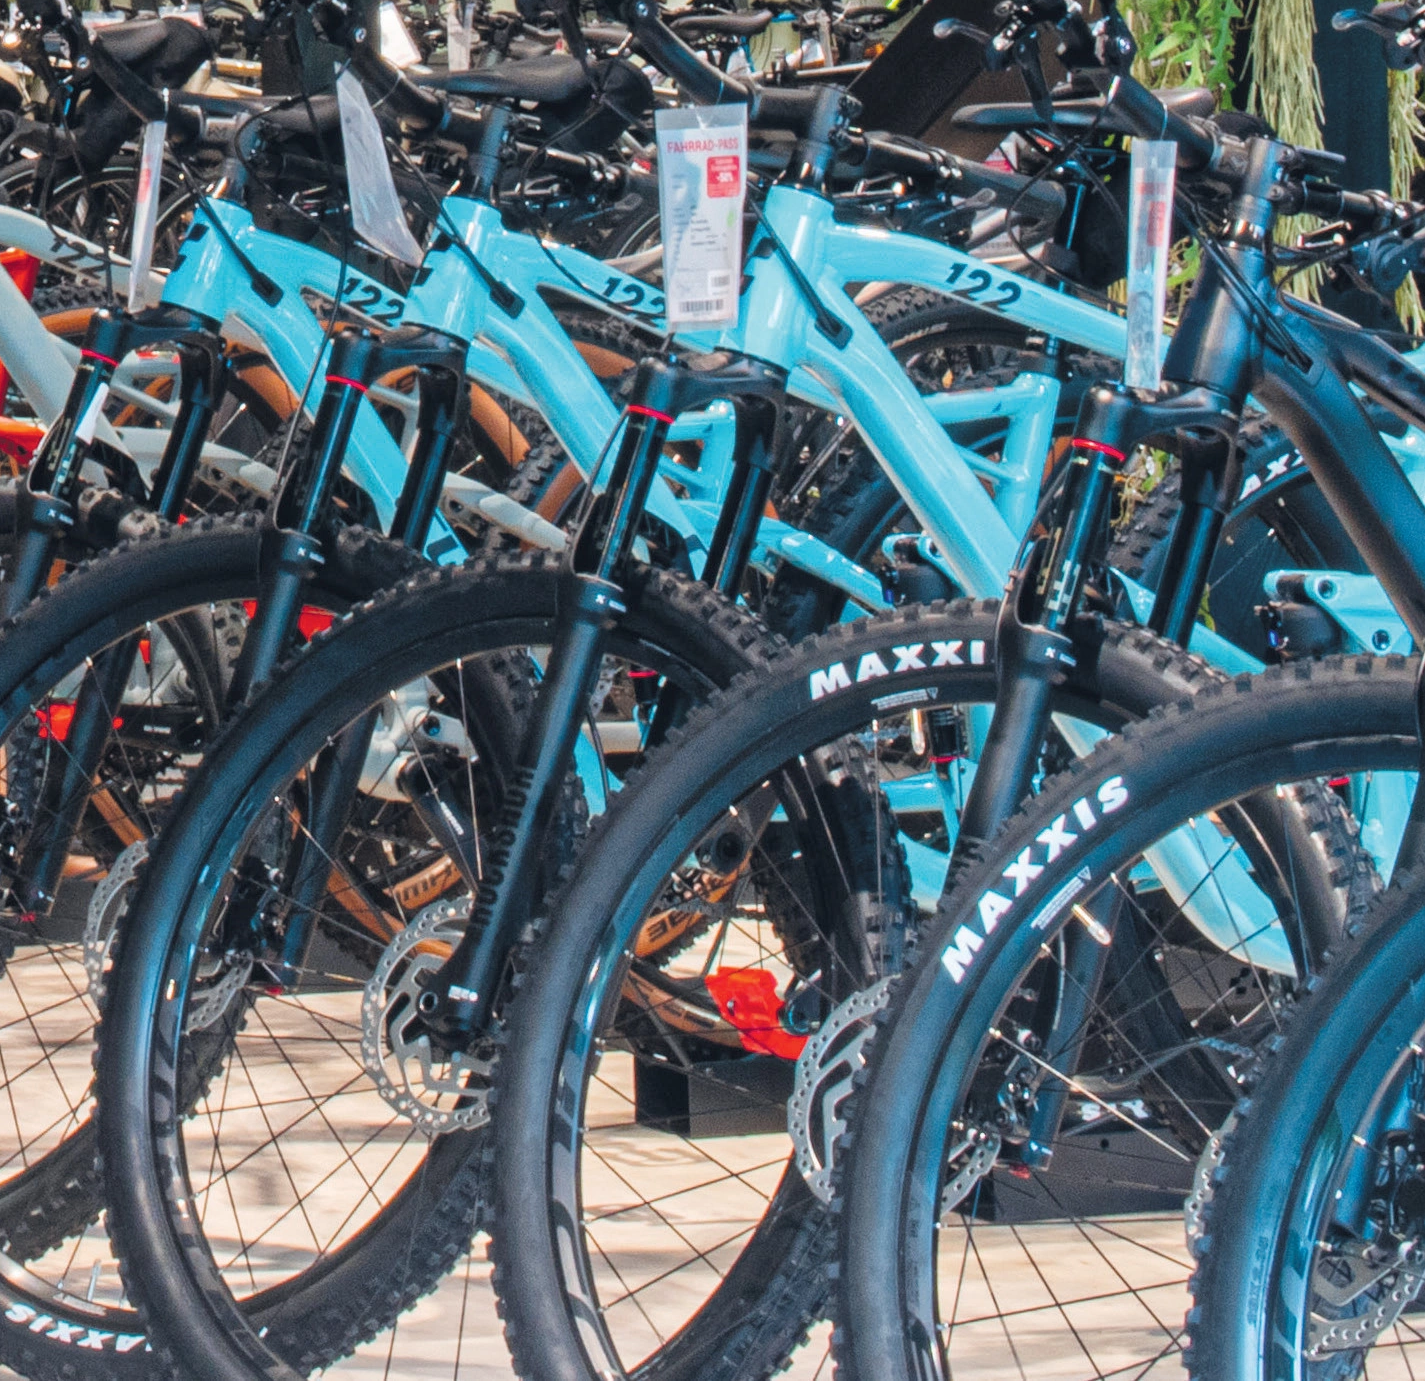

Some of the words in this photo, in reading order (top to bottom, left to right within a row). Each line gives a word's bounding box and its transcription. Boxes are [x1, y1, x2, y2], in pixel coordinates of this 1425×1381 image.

[666, 137, 739, 153] FAHRRAD-PASS
[342, 277, 405, 327] 122
[945, 262, 1021, 312] 122
[810, 640, 986, 701] MAXXI
[941, 775, 1129, 984] MAXXIS
[4, 1303, 153, 1353] AXXIS
